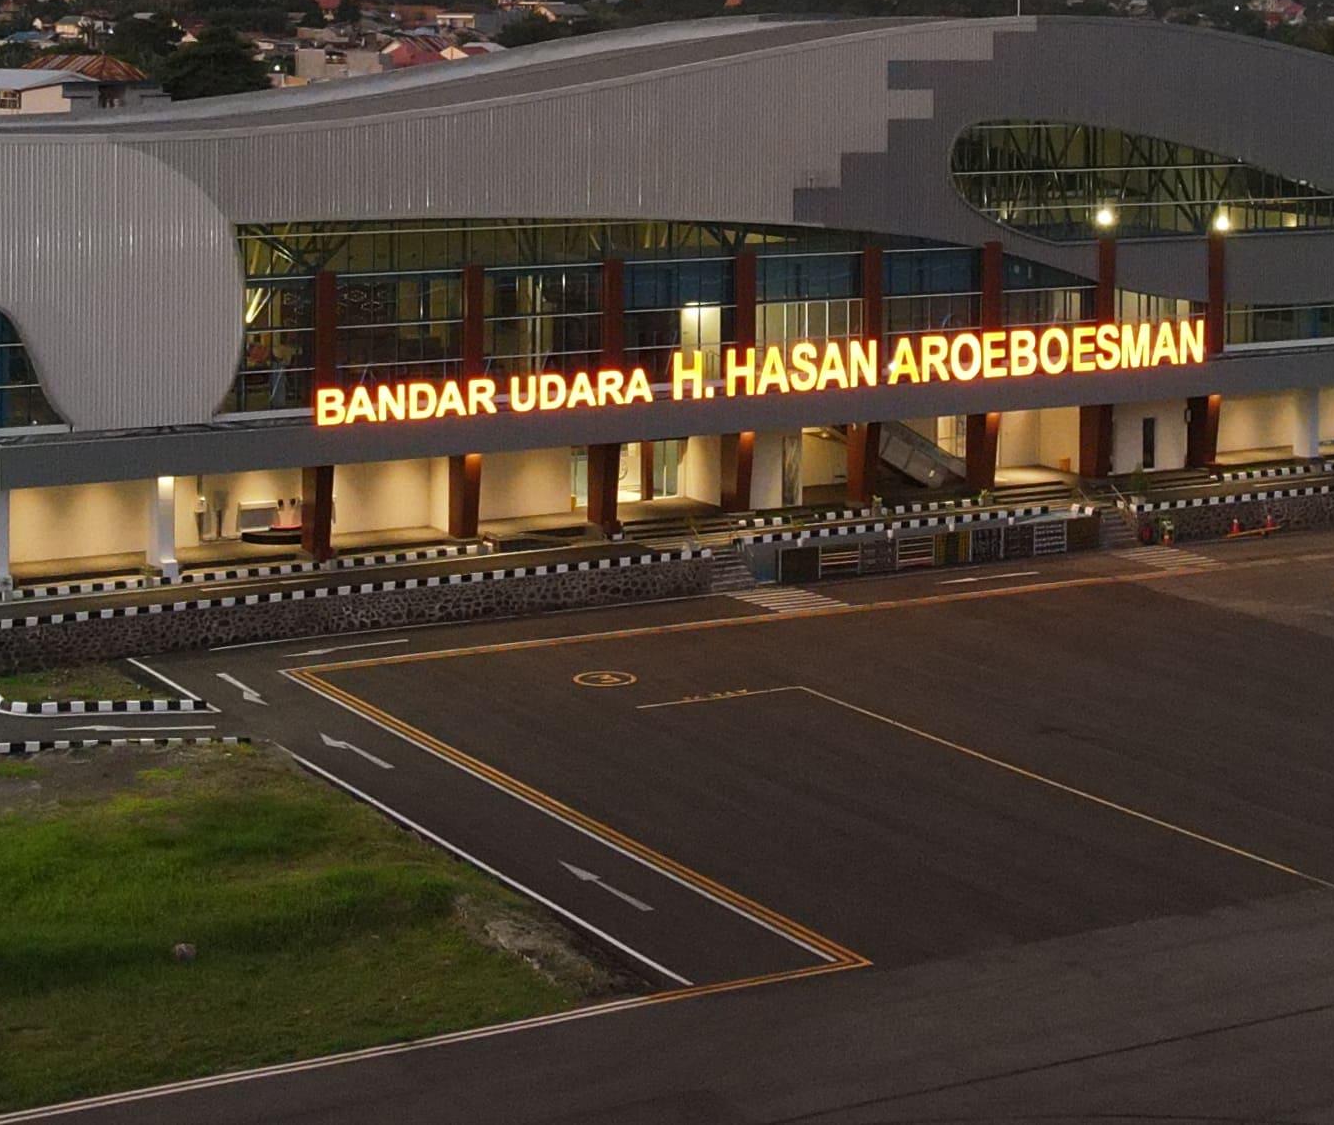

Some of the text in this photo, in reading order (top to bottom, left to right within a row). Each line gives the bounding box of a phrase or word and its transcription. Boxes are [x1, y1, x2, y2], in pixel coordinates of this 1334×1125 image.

[317, 320, 1205, 426] BANDAR UDARA H. HASAN AROEBOESMAN
